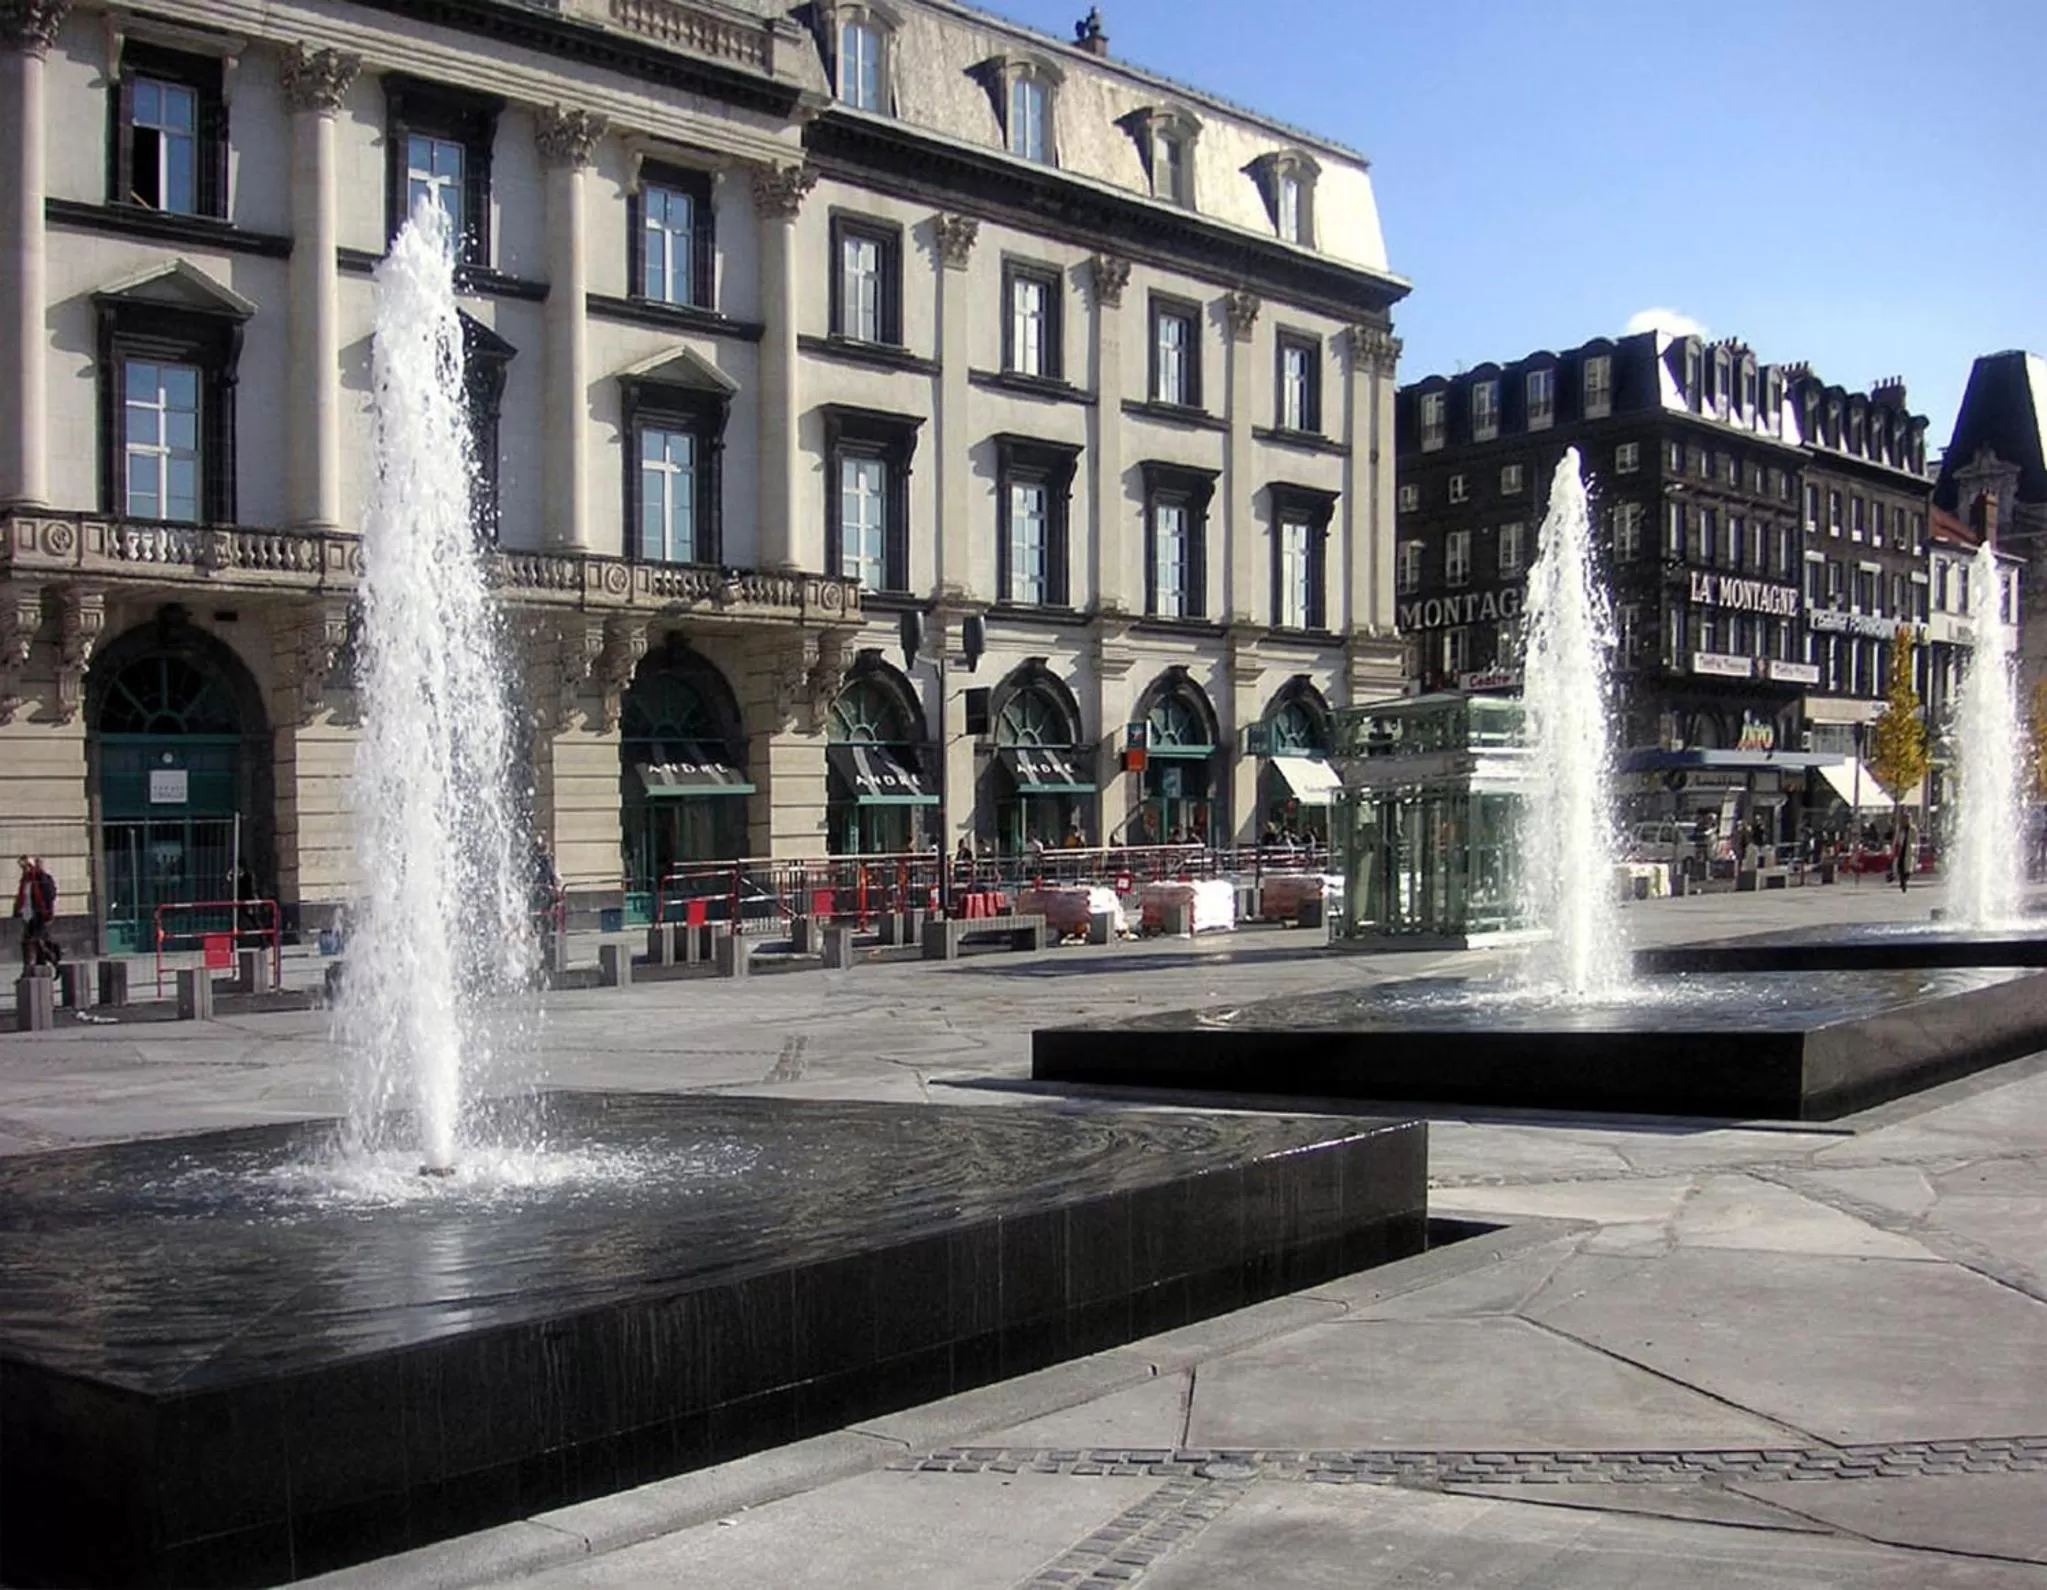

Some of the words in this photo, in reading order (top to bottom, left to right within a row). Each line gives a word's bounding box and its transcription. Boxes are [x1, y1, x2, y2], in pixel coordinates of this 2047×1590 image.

[1400, 588, 1525, 632] MONTAG
[1690, 571, 1716, 604] LA
[1719, 576, 1798, 617] MONTAGNE
